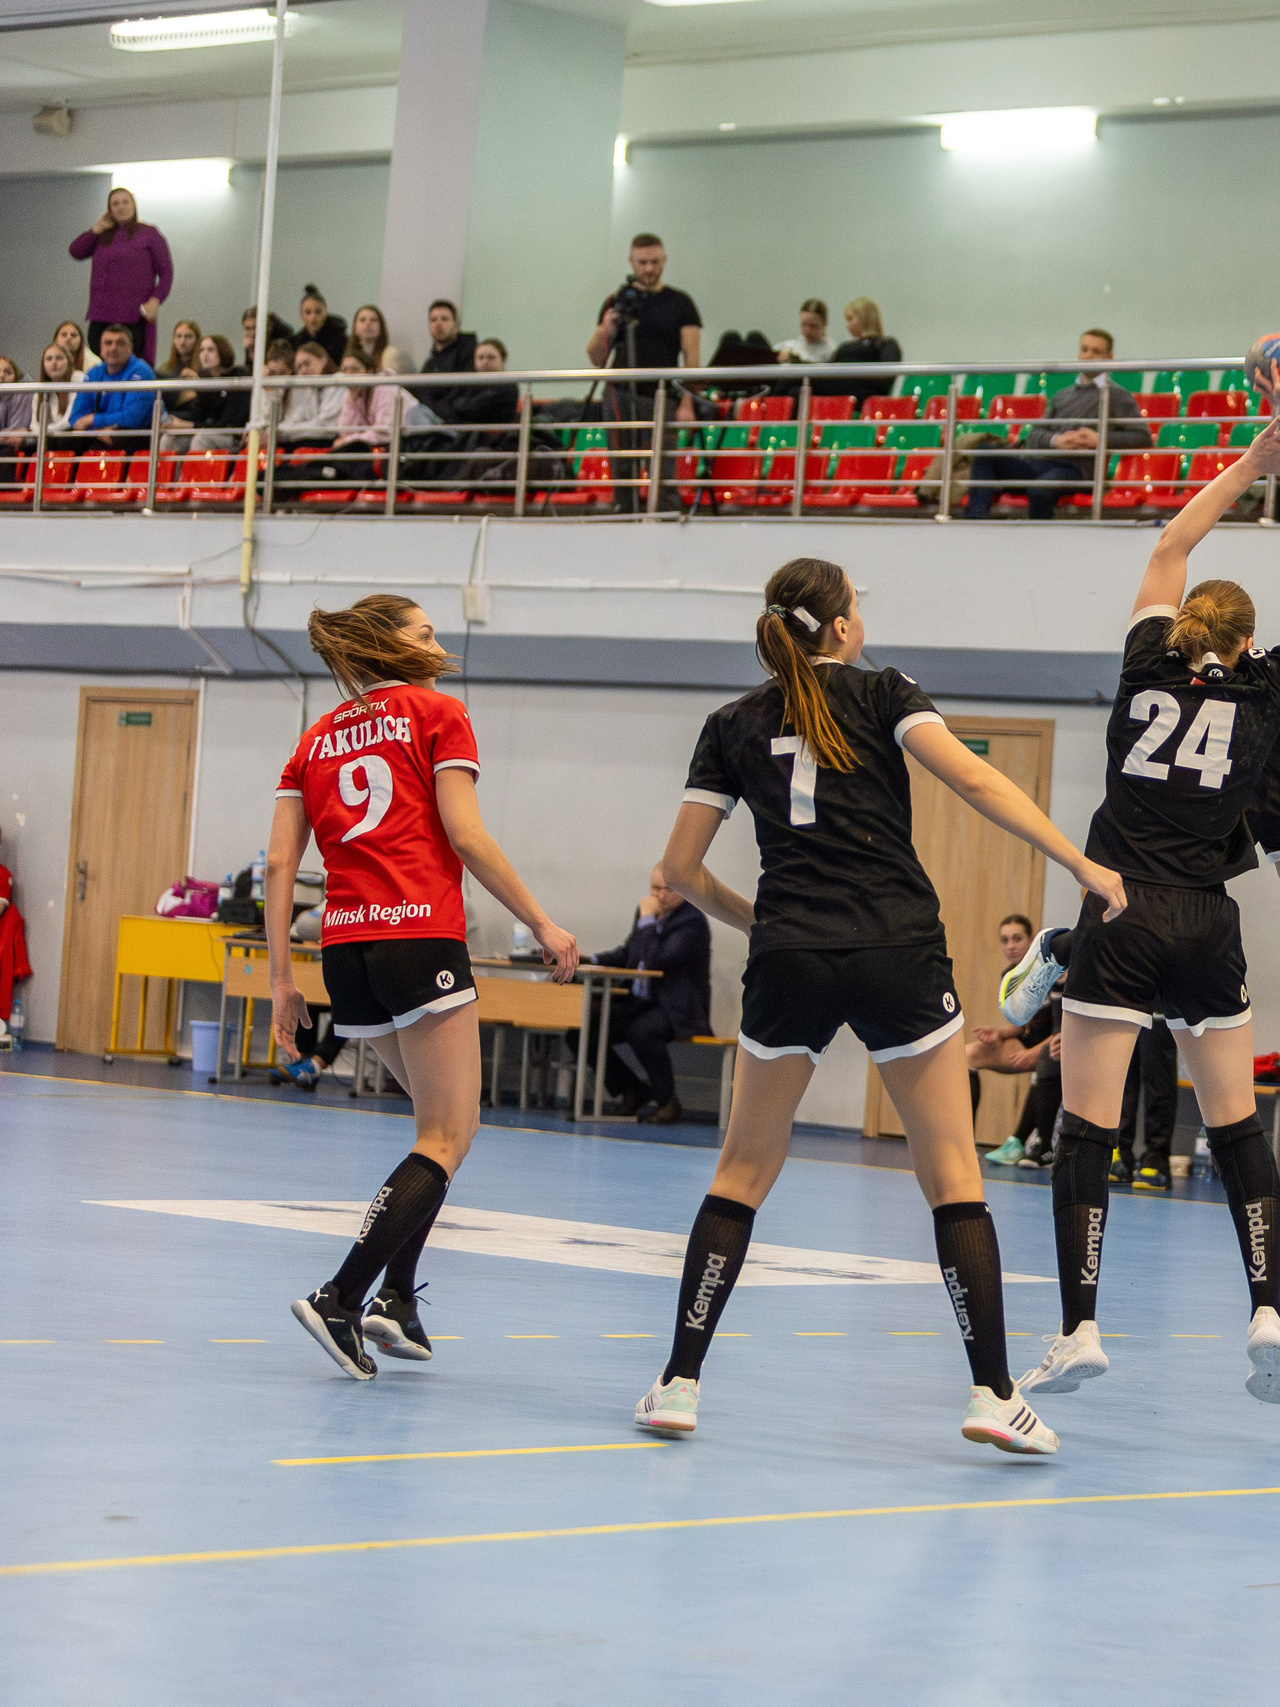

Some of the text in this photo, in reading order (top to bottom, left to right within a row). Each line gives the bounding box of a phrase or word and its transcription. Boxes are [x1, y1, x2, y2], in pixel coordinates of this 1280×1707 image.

[333, 697, 390, 724] SPORTIX
[1121, 690, 1237, 790] 24
[338, 754, 394, 843] 9
[323, 899, 432, 928] Minsk Region
[356, 1186, 394, 1244] Kempa
[1080, 1207, 1103, 1285] Kempa
[1245, 1201, 1270, 1283] Kempa
[685, 1252, 727, 1331] Kempa
[943, 1266, 975, 1341] Kempa
